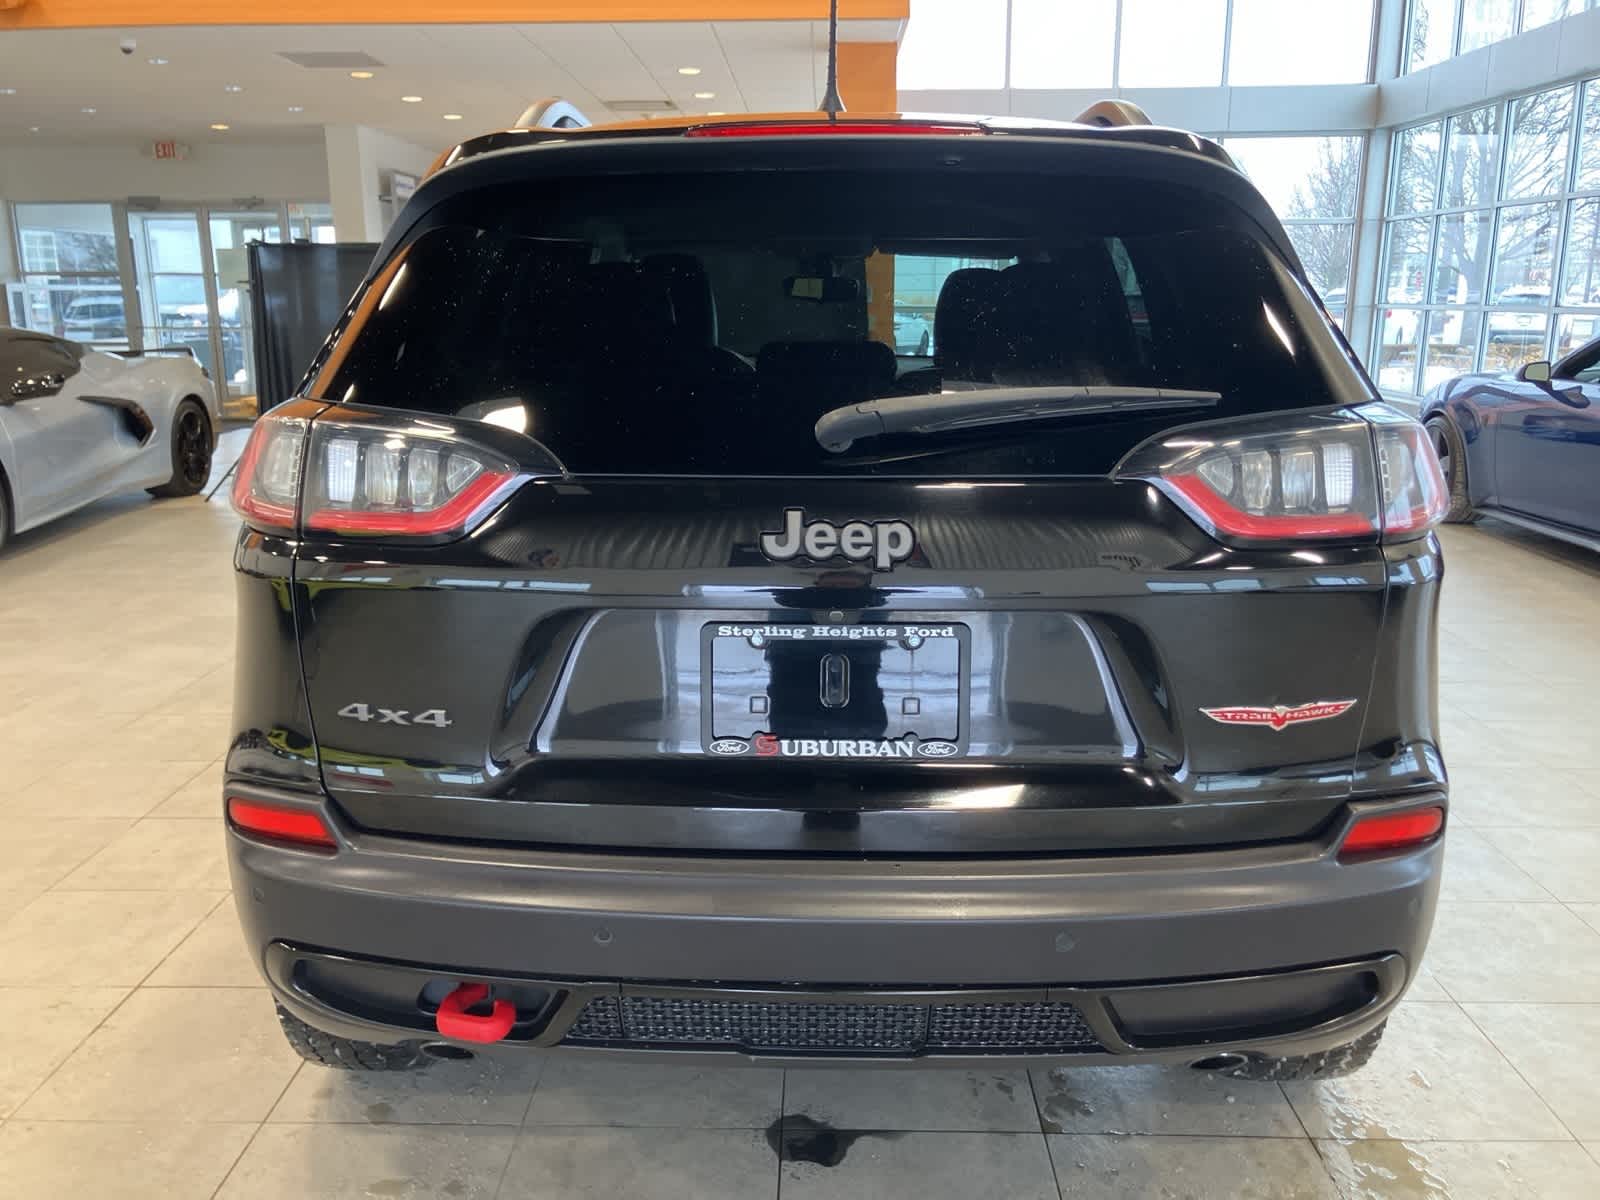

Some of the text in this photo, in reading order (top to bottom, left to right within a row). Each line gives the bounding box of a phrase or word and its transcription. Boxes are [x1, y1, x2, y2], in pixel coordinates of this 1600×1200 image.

[155, 141, 176, 159] EXIT
[761, 508, 914, 570] Jeep
[718, 625, 954, 638] Sterling Heights Ford
[337, 703, 452, 727] 4x4
[719, 741, 741, 753] Ford
[755, 735, 913, 757] SUBURBAN
[926, 743, 950, 755] Ford
